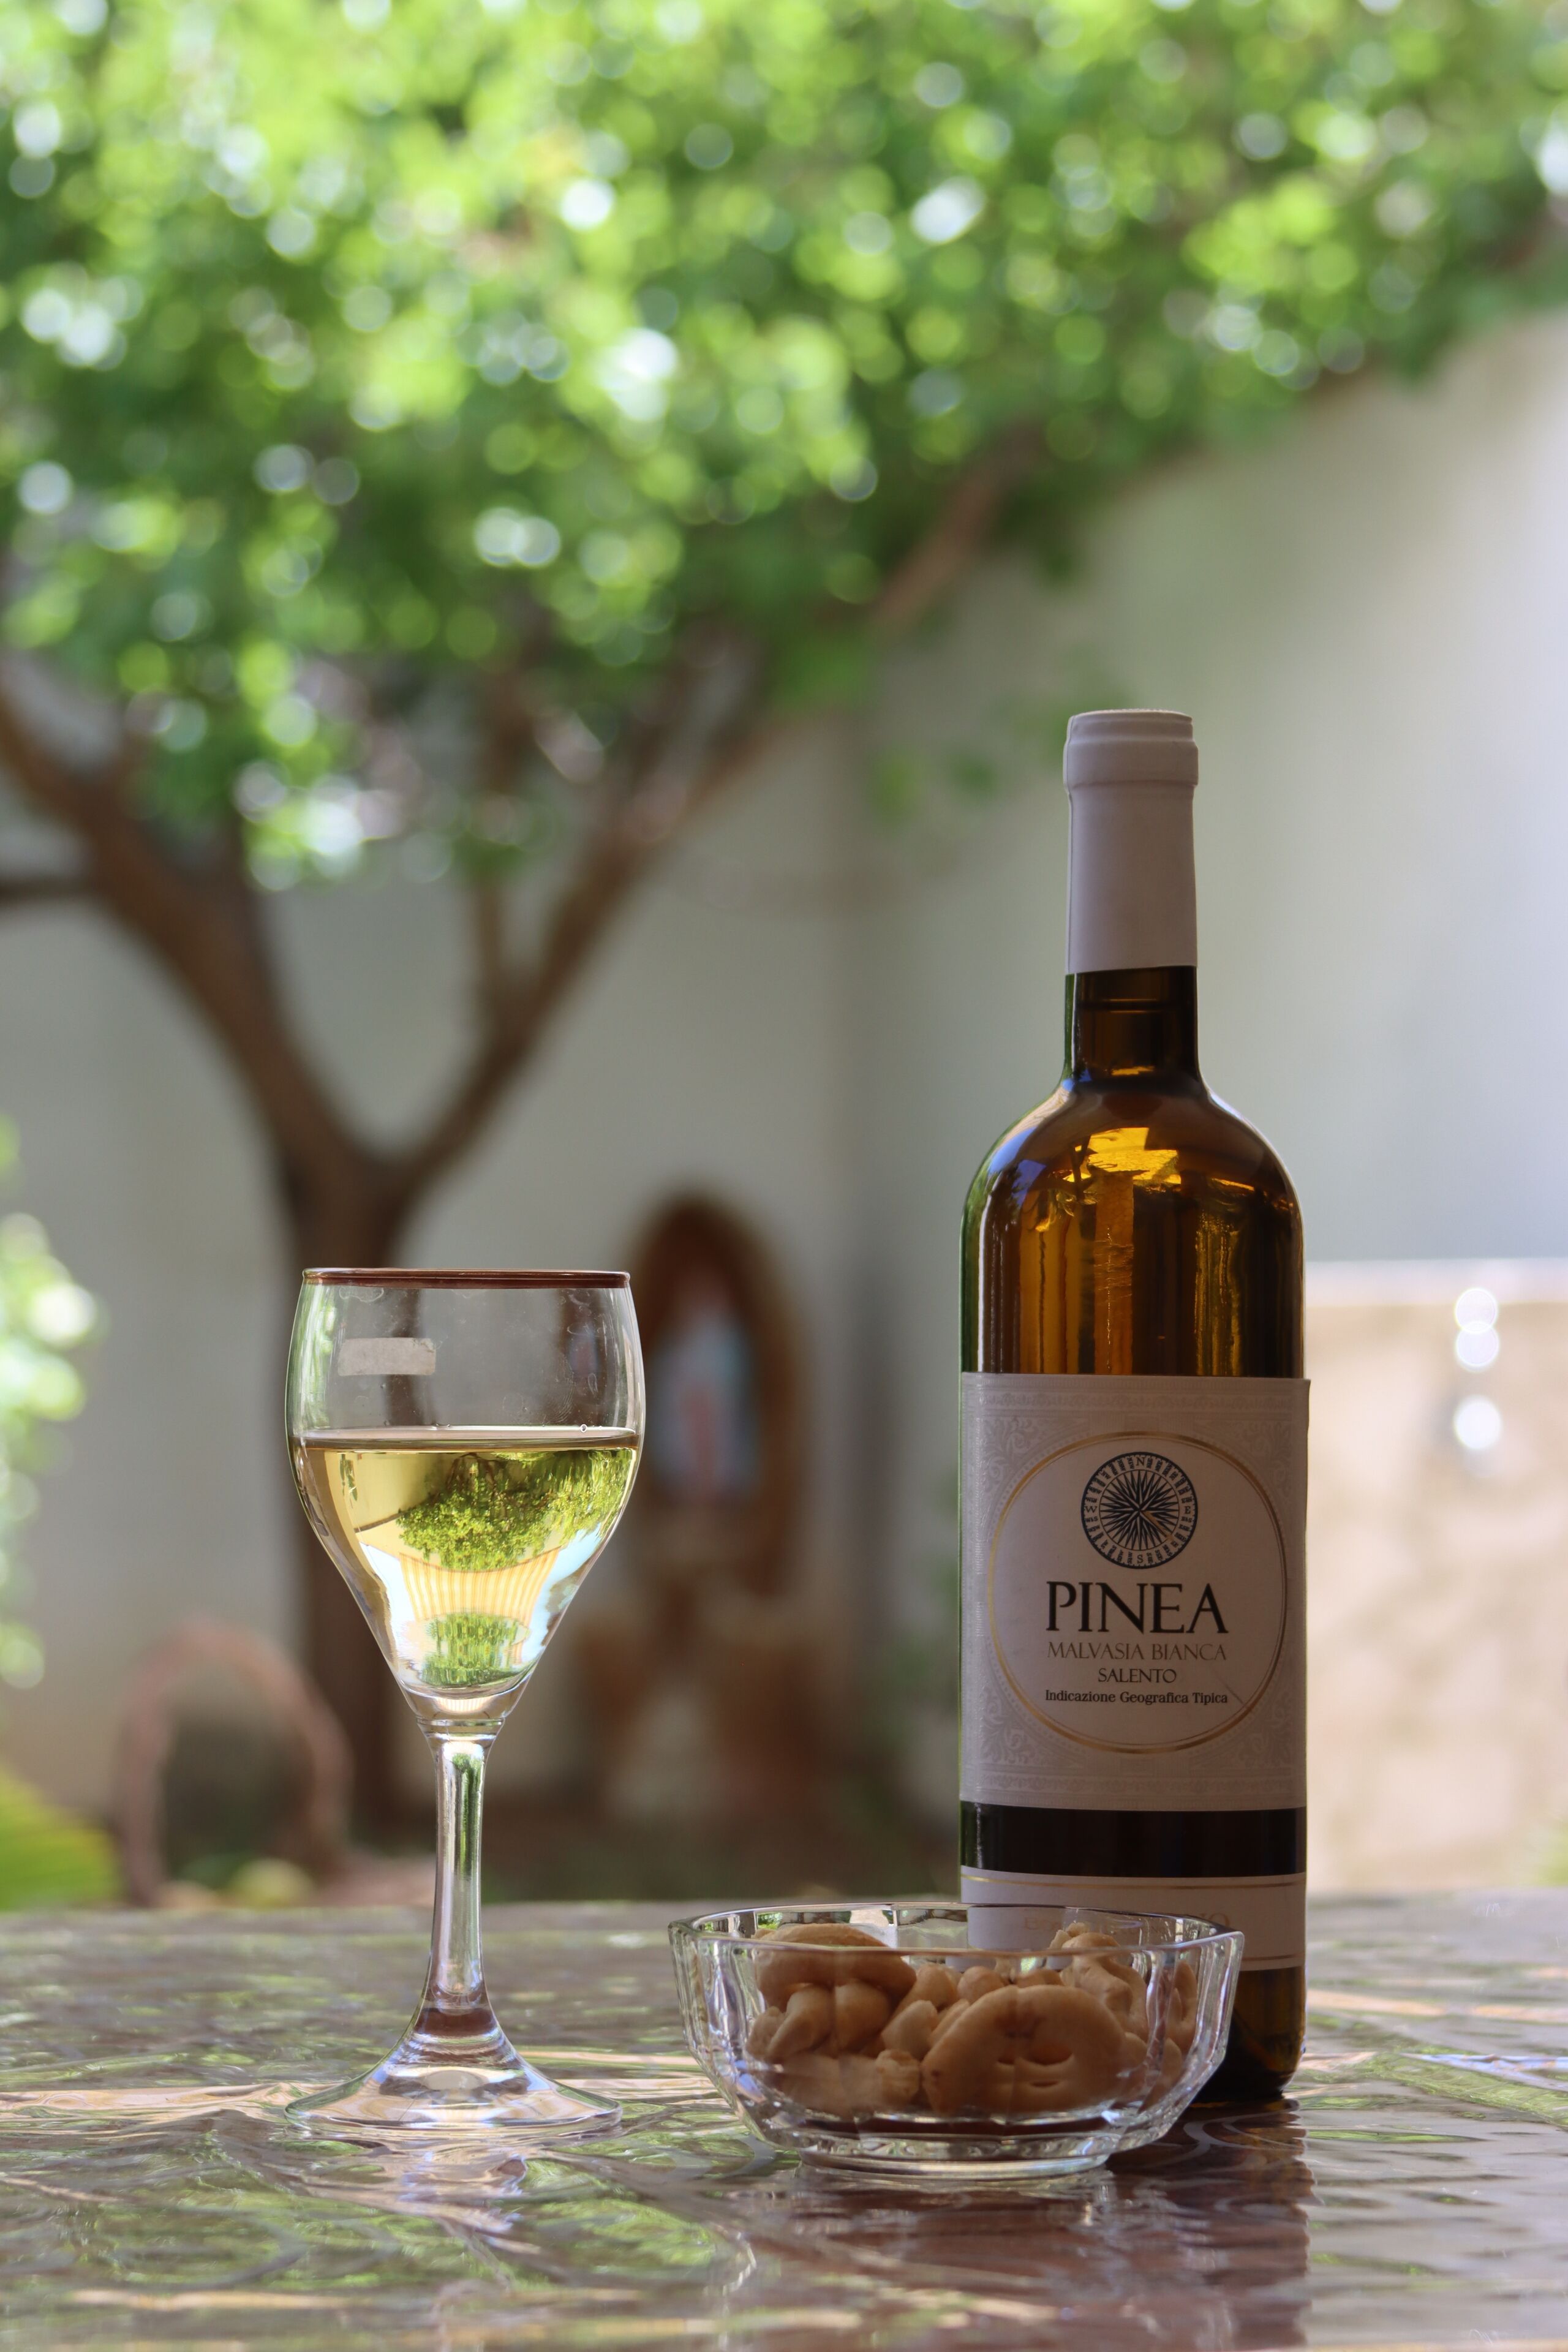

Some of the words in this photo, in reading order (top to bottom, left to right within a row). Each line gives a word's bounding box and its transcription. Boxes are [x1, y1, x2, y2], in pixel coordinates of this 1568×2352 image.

[1136, 1457, 1145, 1466] N
[1137, 1555, 1143, 1564] S
[1046, 1581, 1229, 1634] PINEA
[1047, 1642, 1144, 1660] MALVASIA
[1152, 1643, 1227, 1660] BIANCA
[1098, 1668, 1177, 1683] SALENTO
[1045, 1689, 1116, 1702] Indicazione
[1120, 1691, 1189, 1705] Geografica
[1193, 1692, 1228, 1705] Tipica
